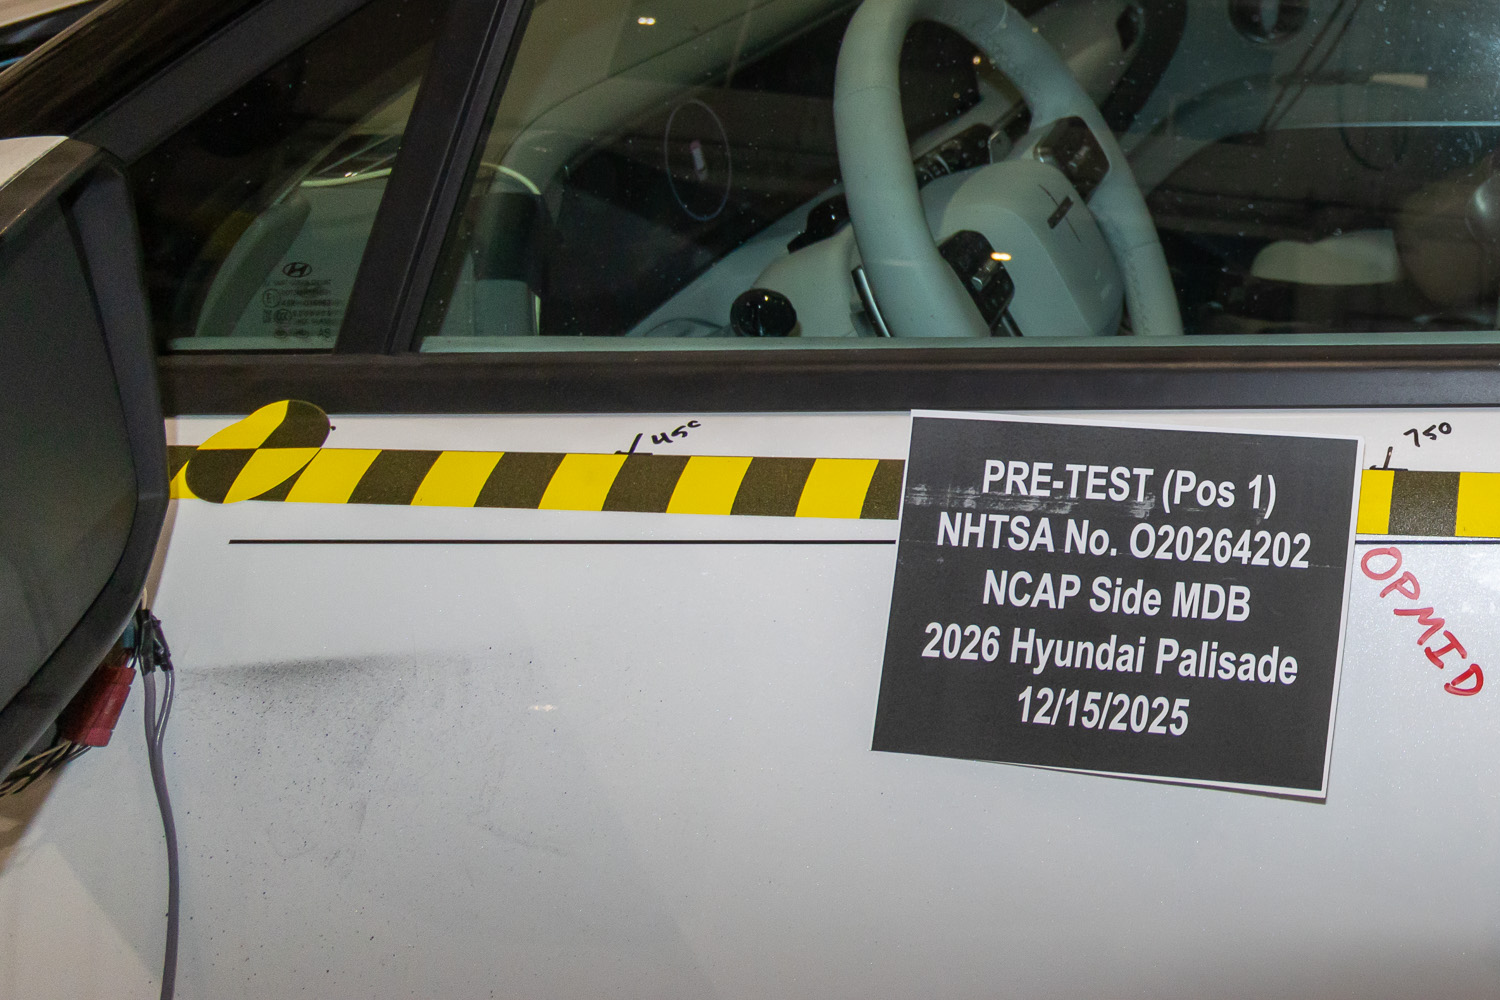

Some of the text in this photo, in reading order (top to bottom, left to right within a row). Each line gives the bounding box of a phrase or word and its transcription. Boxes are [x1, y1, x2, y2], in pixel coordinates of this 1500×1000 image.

[1403, 422, 1452, 448] 750
[982, 459, 1277, 519] PRE-TEST (Pos 1)
[936, 511, 1055, 553] NHTSA
[1064, 518, 1118, 557] No.
[982, 569, 1252, 622] NCAP Side MDB
[921, 622, 1298, 685] 2026 Hyundai Palisade
[1018, 685, 1190, 736] 12/15/2025
